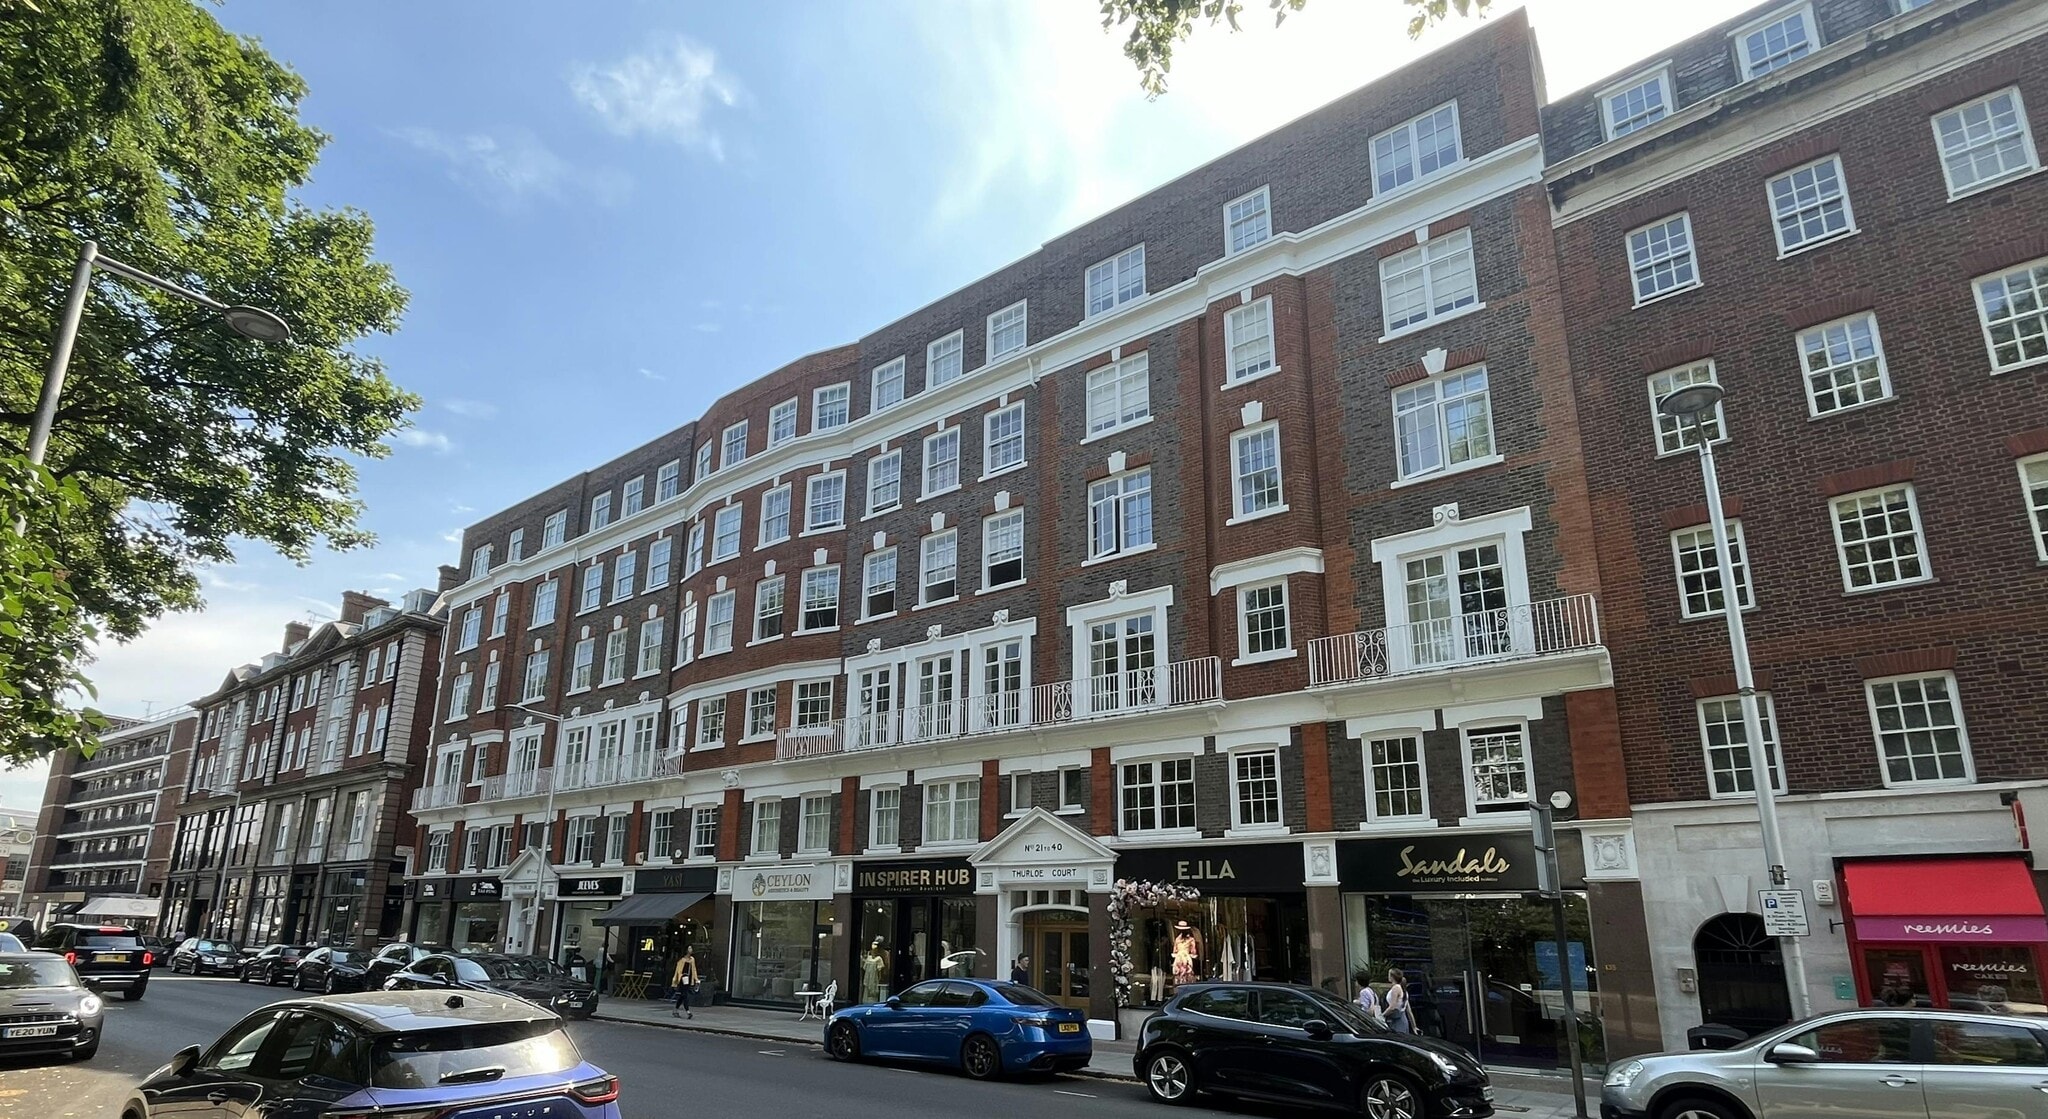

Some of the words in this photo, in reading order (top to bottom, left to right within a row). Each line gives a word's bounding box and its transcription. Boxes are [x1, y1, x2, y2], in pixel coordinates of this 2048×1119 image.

[1051, 843, 1063, 851] 40
[1396, 845, 1510, 876] Sandals
[859, 869, 930, 887] INSPIRER
[935, 868, 970, 885] HUB
[1012, 869, 1044, 877] THURLOE
[1052, 868, 1077, 876] COURT
[577, 880, 600, 890] JEEVES
[767, 873, 811, 887] CEYLON
[1903, 920, 1993, 934] reemies
[1952, 961, 2027, 972] reemies
[10, 1028, 35, 1036] YE20
